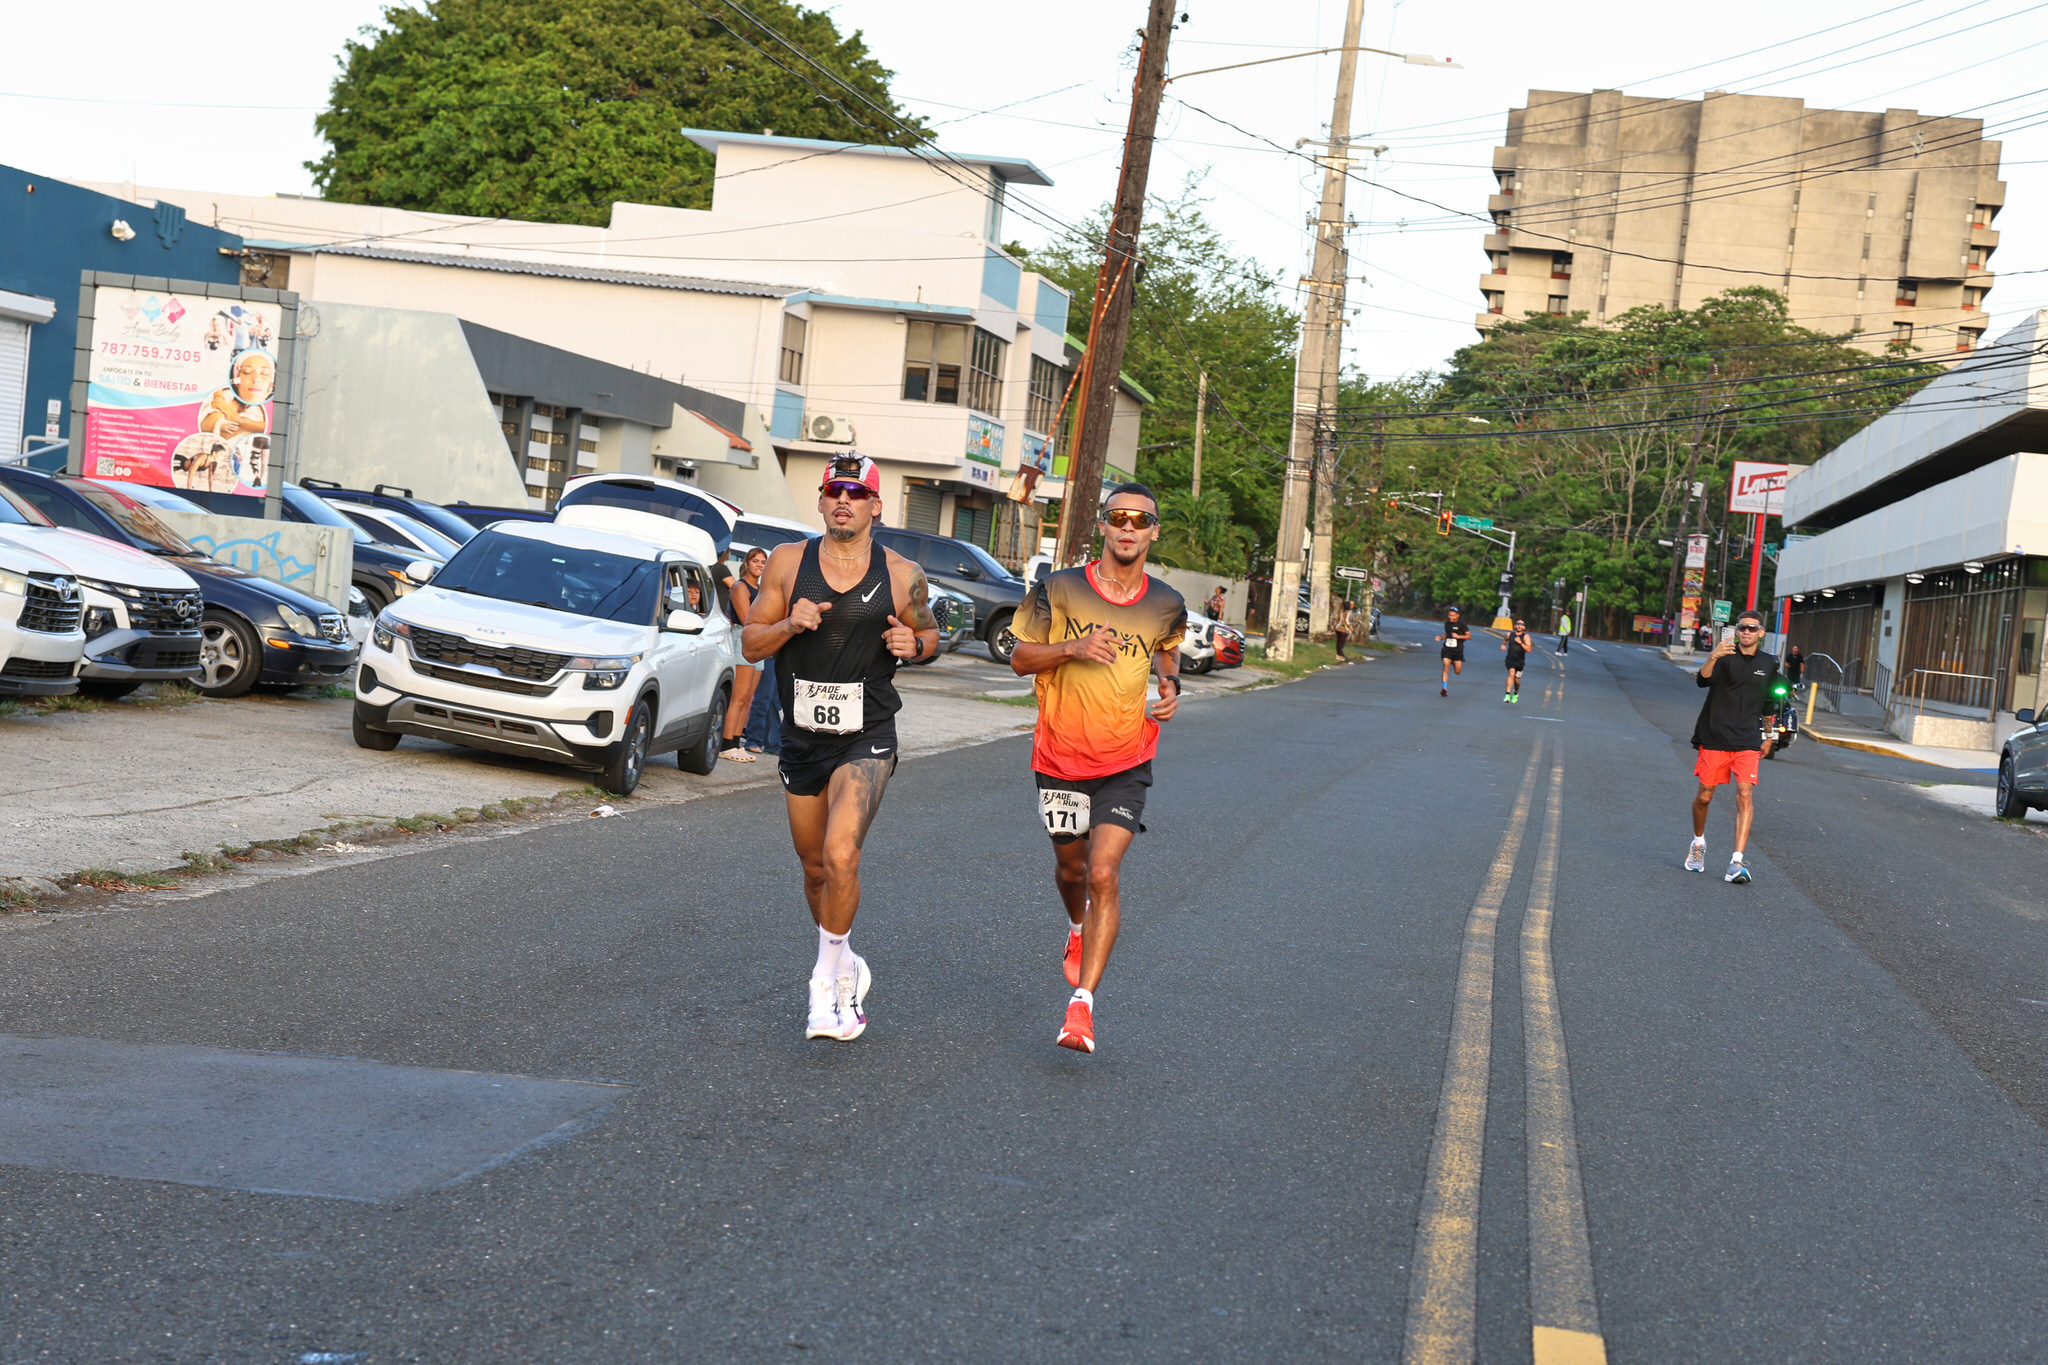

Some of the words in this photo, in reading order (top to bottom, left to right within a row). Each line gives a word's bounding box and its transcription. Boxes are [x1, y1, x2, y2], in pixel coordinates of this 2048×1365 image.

[101, 342, 201, 363] 787.759.7305
[99, 374, 132, 386] SALUD
[133, 378, 141, 387] &
[143, 379, 198, 392] BIENESTAR
[816, 685, 840, 693] FADE
[814, 705, 840, 725] 68
[1051, 791, 1072, 800] FADE
[1063, 800, 1079, 808] RUN
[1045, 810, 1077, 830] 171
